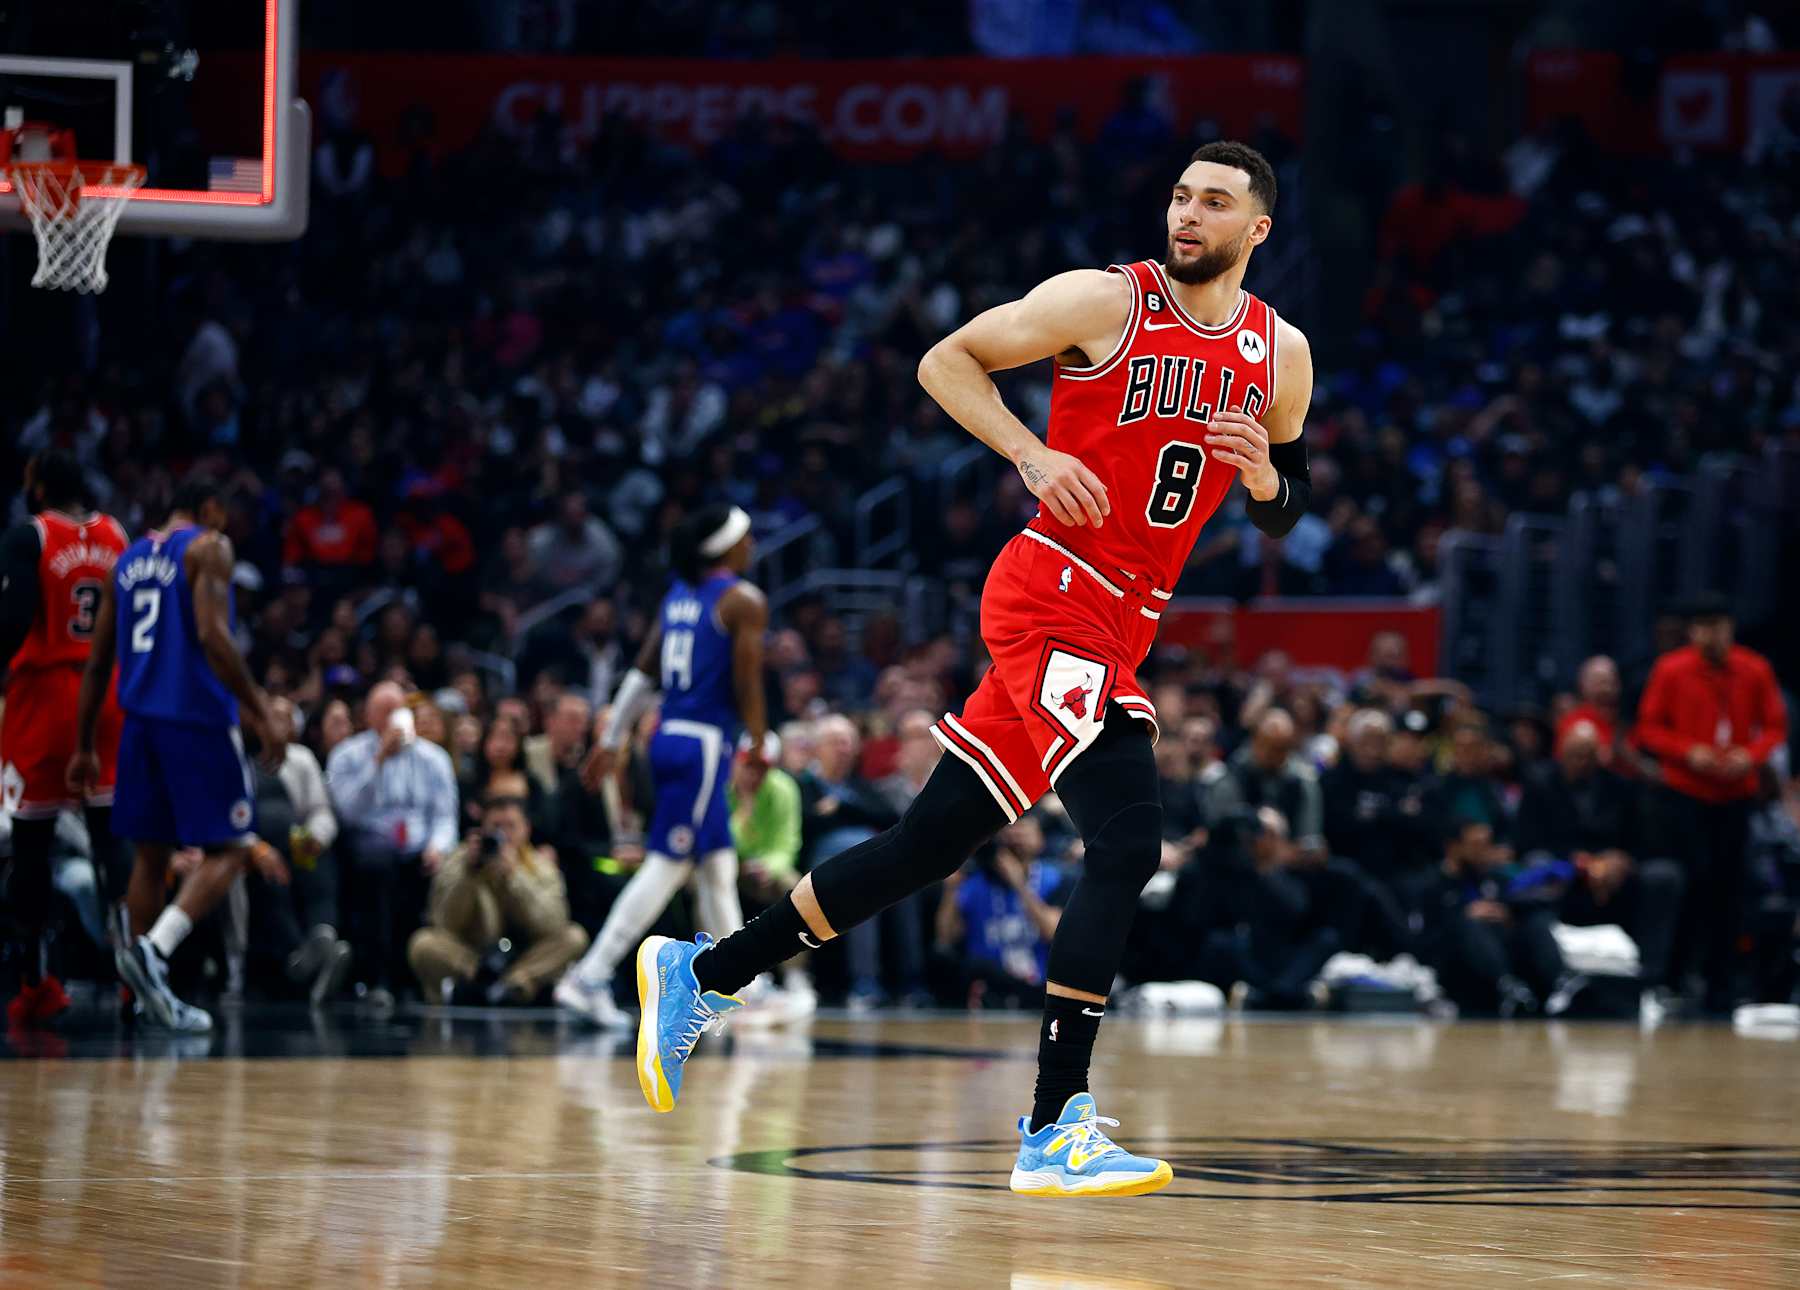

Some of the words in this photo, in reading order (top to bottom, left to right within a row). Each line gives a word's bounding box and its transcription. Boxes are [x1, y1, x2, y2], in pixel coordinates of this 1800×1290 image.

[1147, 293, 1160, 311] 6
[1145, 440, 1206, 529] 8
[131, 587, 161, 652] 2
